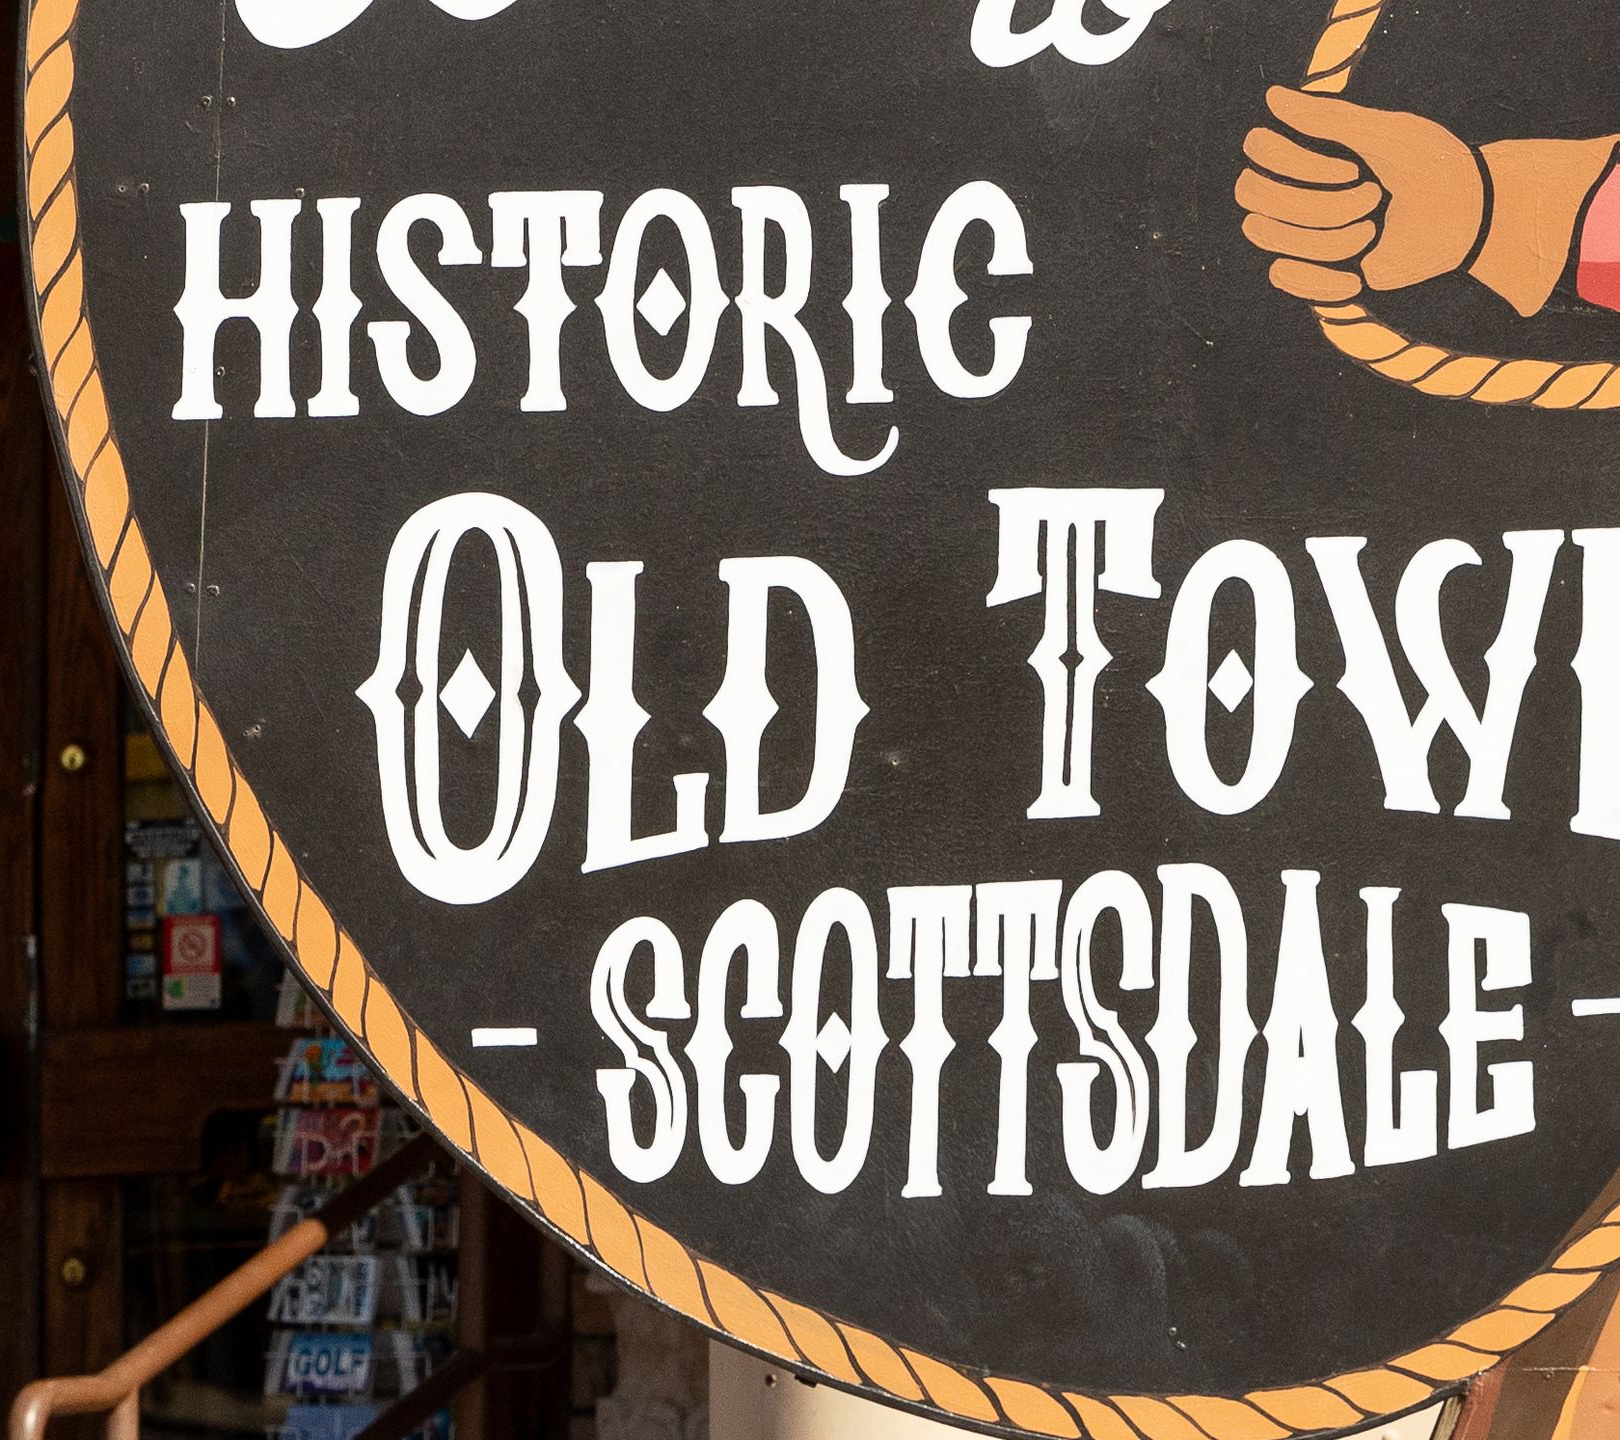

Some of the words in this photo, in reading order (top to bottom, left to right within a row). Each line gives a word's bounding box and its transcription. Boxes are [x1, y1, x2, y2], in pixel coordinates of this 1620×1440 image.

[171, 180, 1035, 477] HISTORIC
[355, 491, 871, 905] OLD
[590, 862, 1535, 1199] SCOTTSDALE
